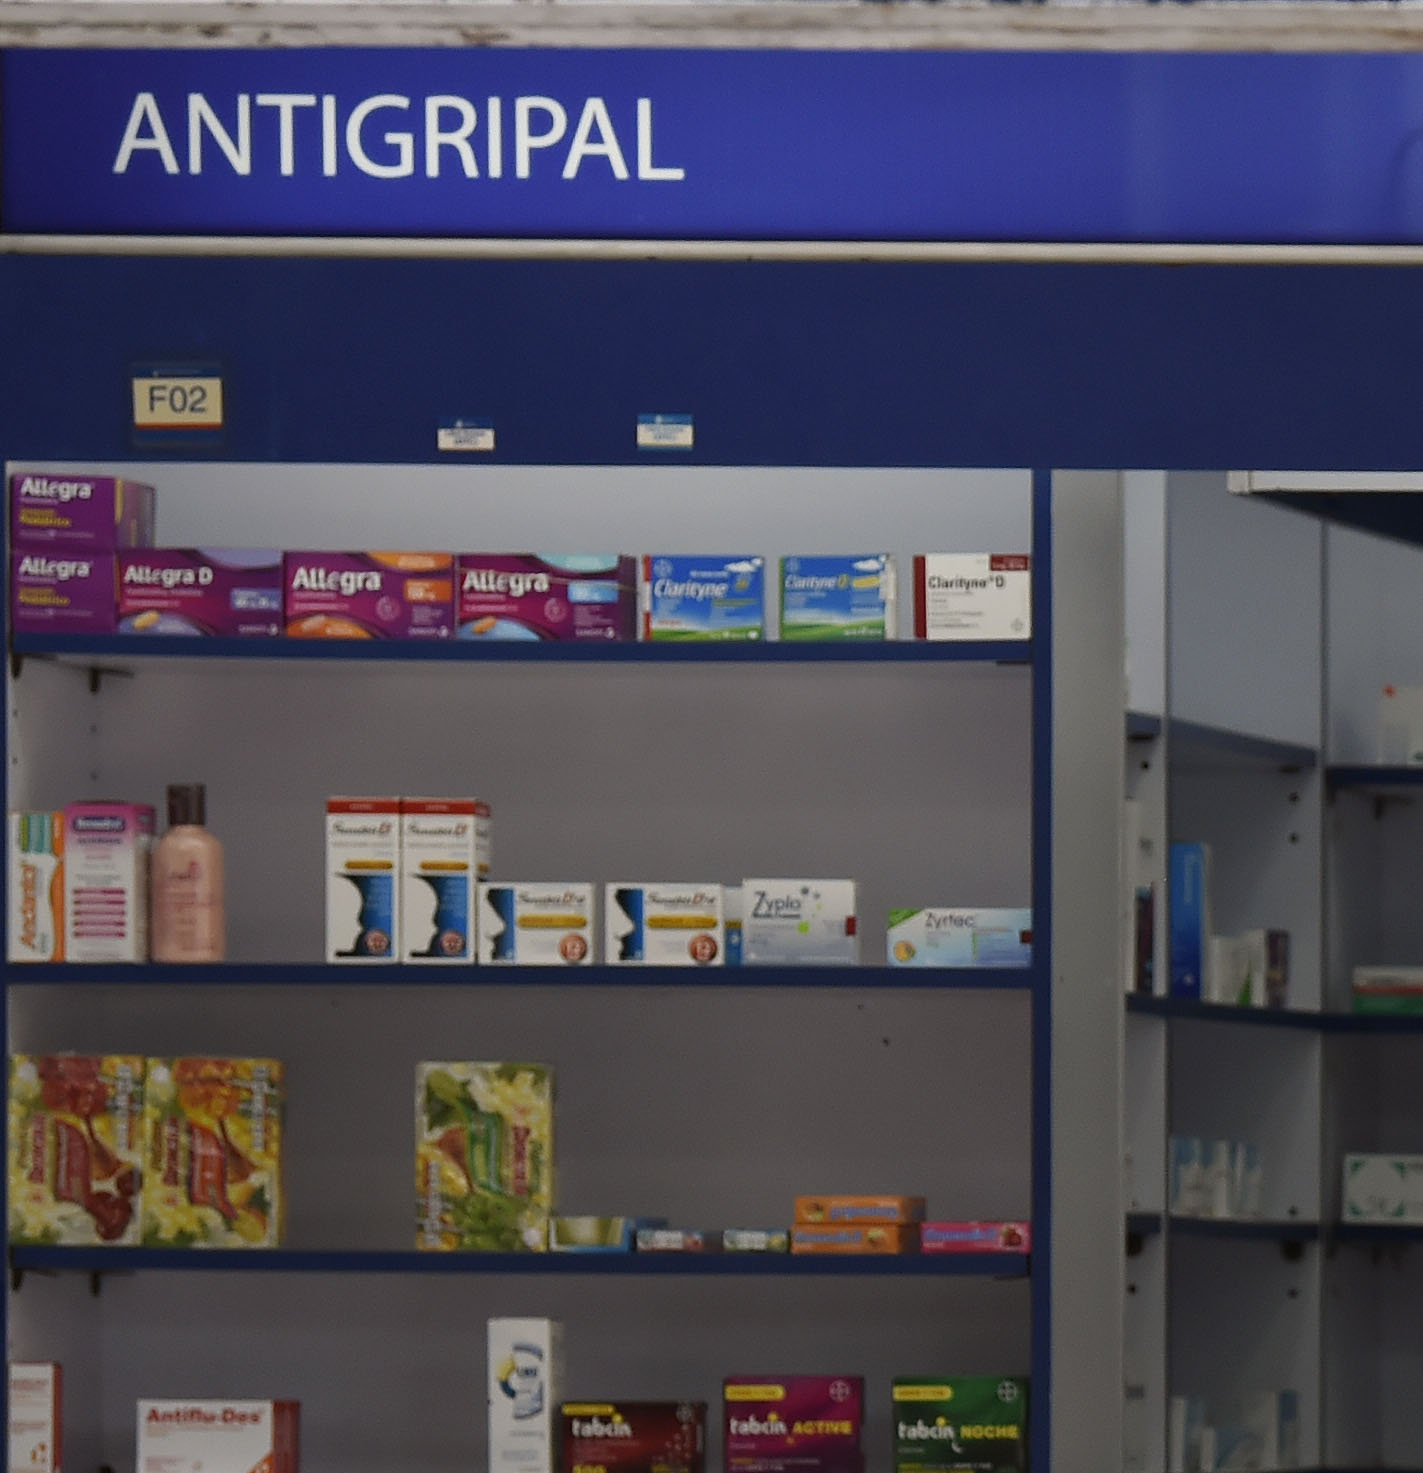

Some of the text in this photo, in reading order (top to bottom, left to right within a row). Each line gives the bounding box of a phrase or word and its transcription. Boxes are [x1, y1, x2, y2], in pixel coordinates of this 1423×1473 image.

[113, 92, 685, 182] ANTIGRIPAL
[147, 387, 208, 412] F02
[124, 565, 195, 586] Allegra
[292, 566, 381, 592] Allegra
[652, 576, 728, 601] Clarityne
[571, 1416, 632, 1438] tabcin
[730, 1416, 852, 1436] tabcin ACTIVE
[898, 1421, 1020, 1440] tabcin NOCHE
